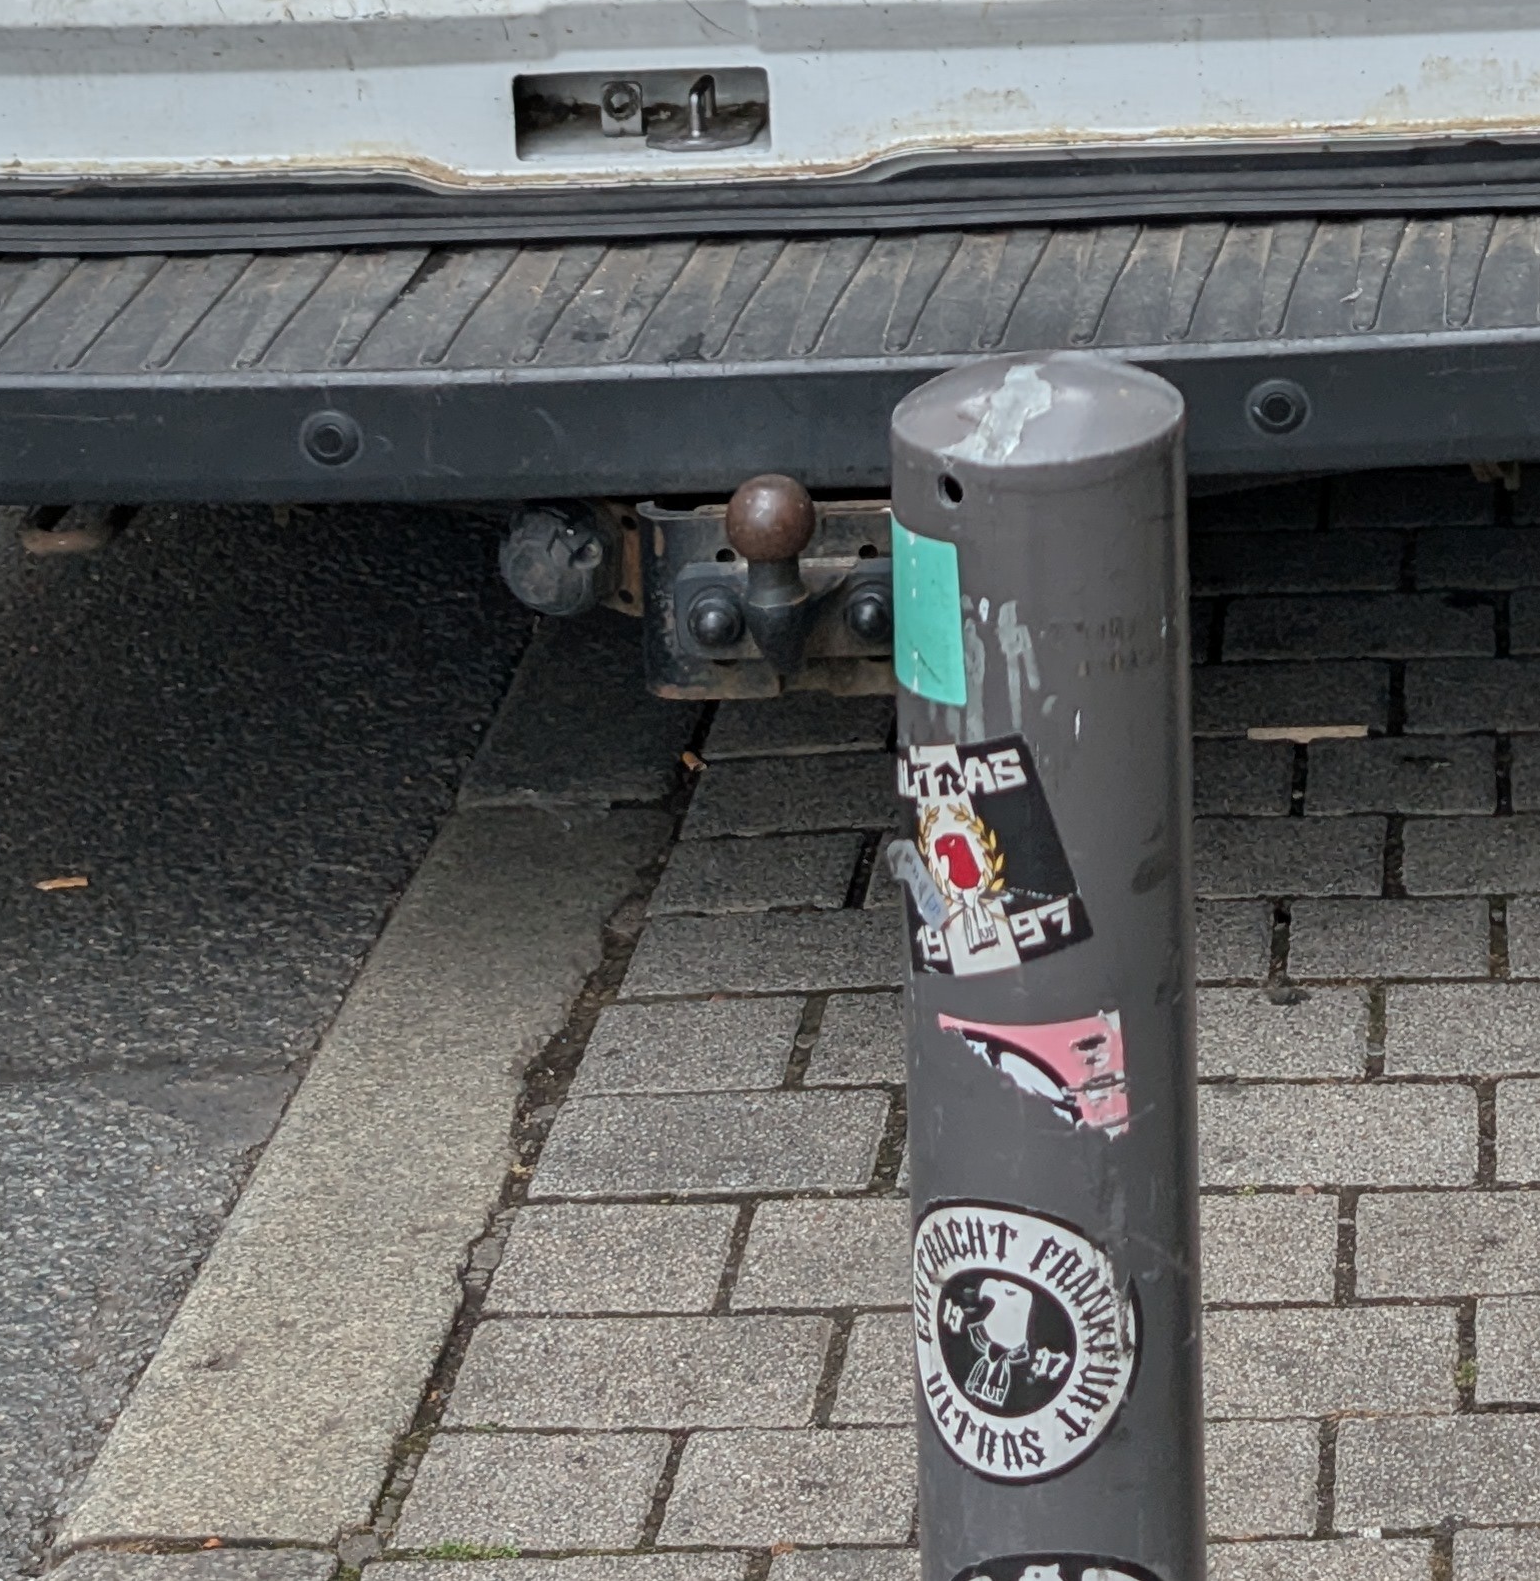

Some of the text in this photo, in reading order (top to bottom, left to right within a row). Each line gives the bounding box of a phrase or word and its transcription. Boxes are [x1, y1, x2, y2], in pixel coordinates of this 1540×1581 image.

[1009, 897, 1072, 948] 97
[913, 1215, 1019, 1345] EINTRACHT
[926, 1370, 1047, 1472] ULTRAS
